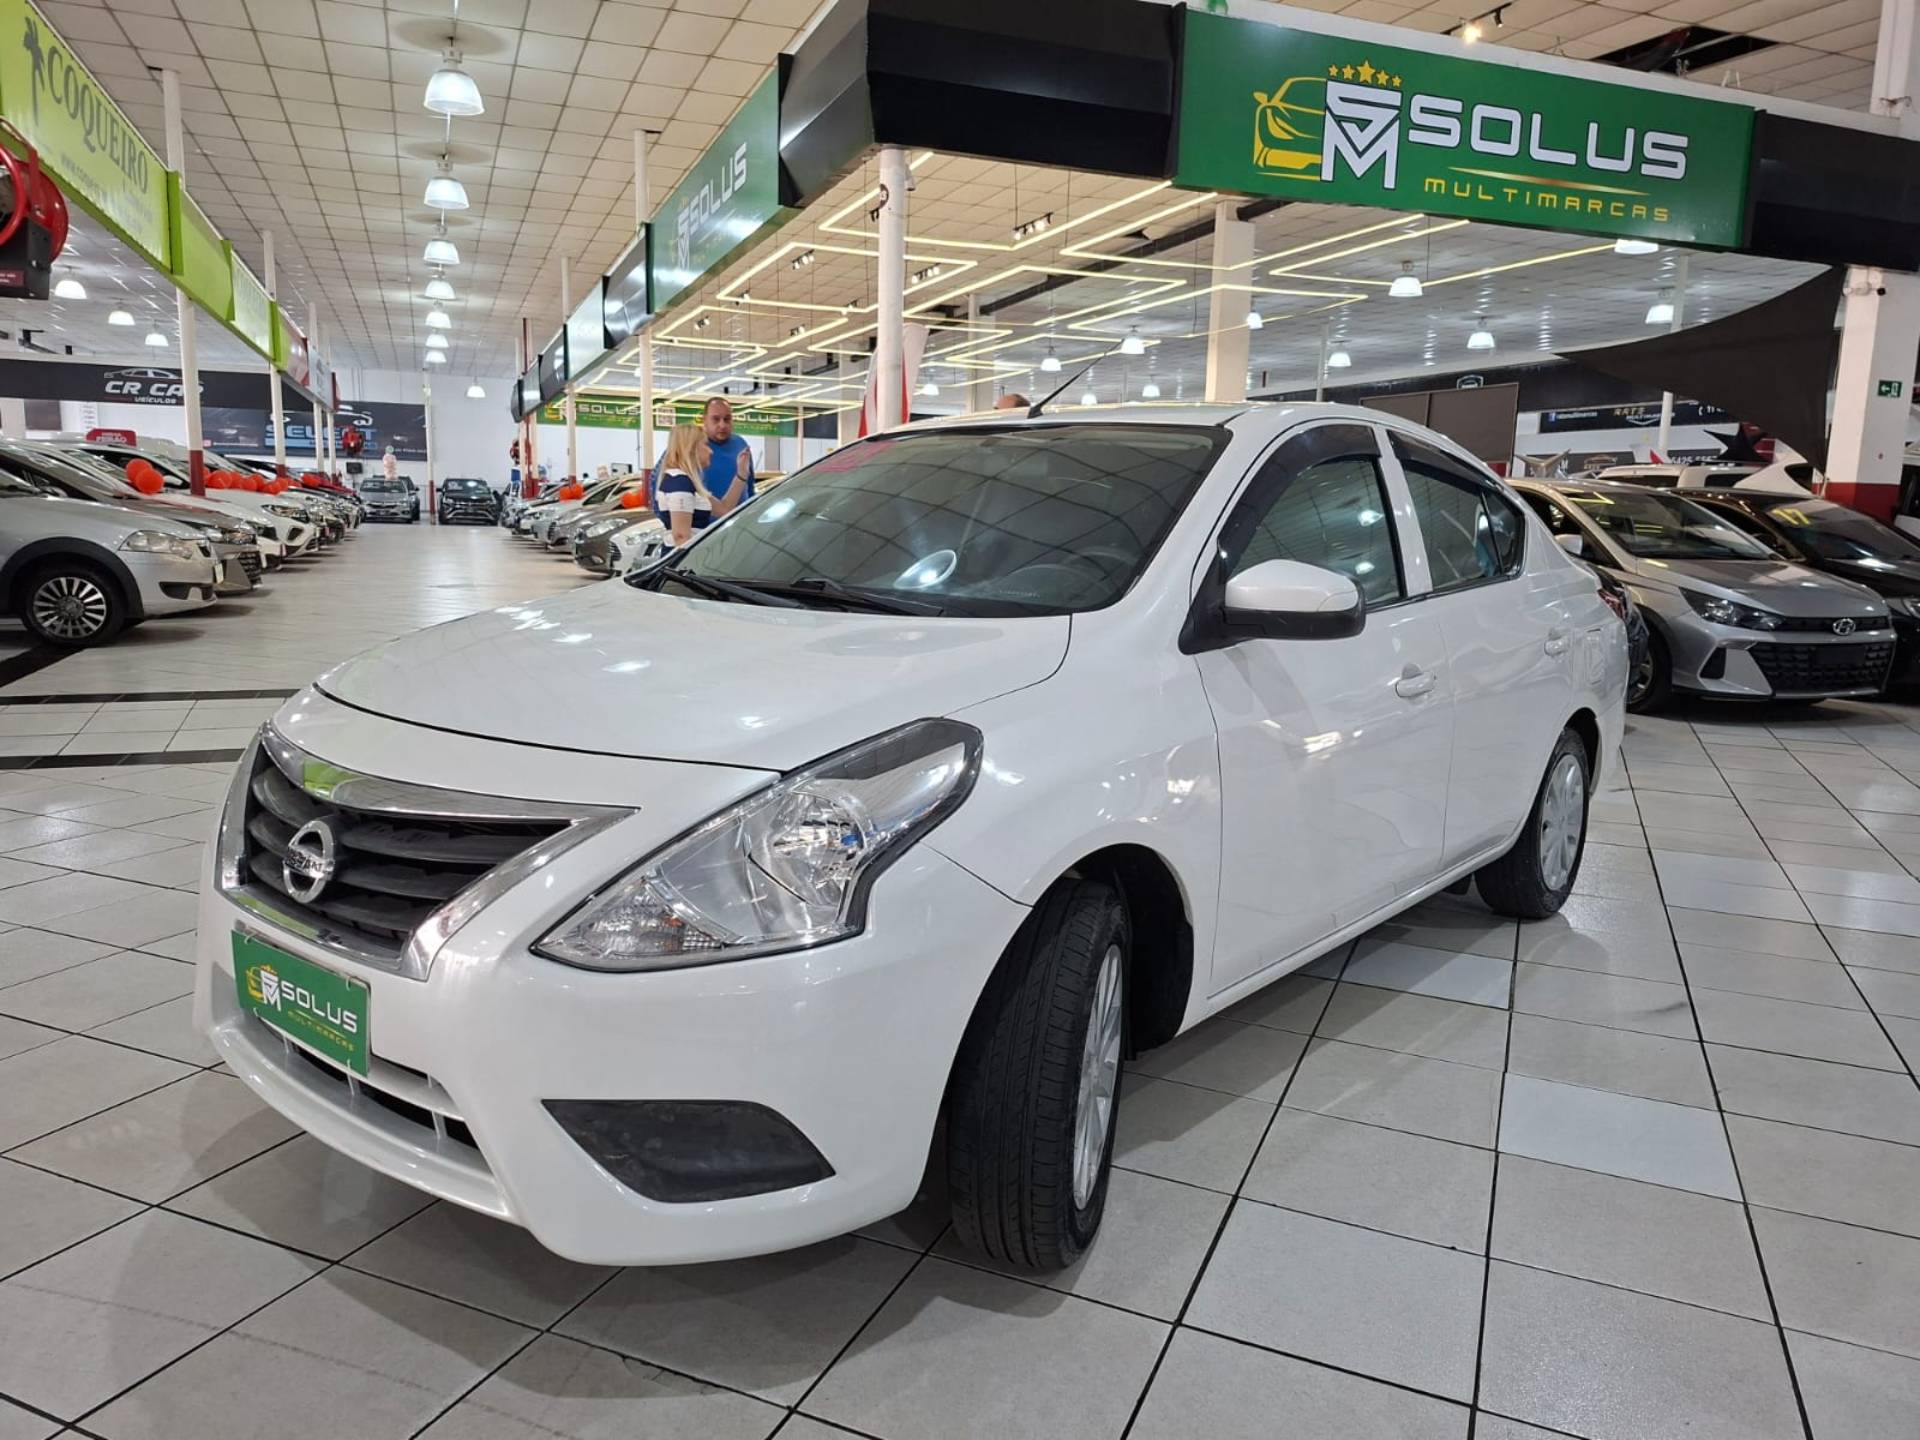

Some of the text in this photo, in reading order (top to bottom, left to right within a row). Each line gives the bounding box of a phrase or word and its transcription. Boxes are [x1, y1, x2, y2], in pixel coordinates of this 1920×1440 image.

[47, 46, 149, 194] COQUEIRO
[1408, 93, 1689, 181] SOLUS
[690, 142, 747, 235] SOLUS
[1424, 177, 1670, 223] MULTIMARCAS
[105, 381, 142, 395] CR
[281, 982, 358, 1033] SOLUS
